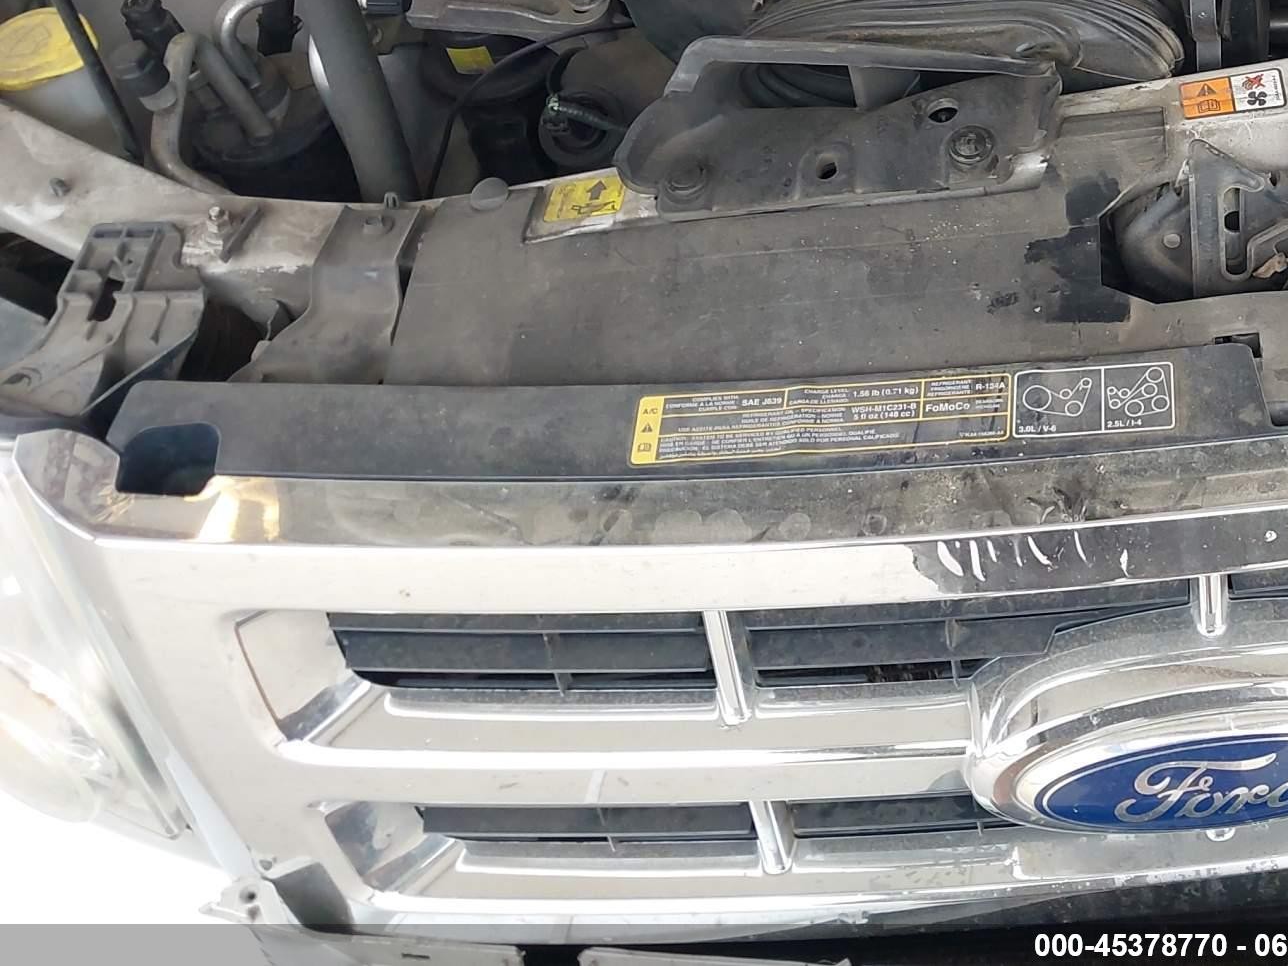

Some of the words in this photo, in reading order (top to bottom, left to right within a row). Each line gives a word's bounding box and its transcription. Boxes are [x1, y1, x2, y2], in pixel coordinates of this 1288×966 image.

[975, 381, 1005, 390] R-134A
[870, 388, 880, 397] lb
[903, 386, 919, 395] kg)
[741, 398, 760, 406] SAE
[924, 400, 970, 413] FoMoCo
[641, 407, 658, 415] A/C
[1106, 419, 1124, 428] 2.5L
[1018, 424, 1036, 434] 3.0L
[1042, 424, 1056, 433] V-6
